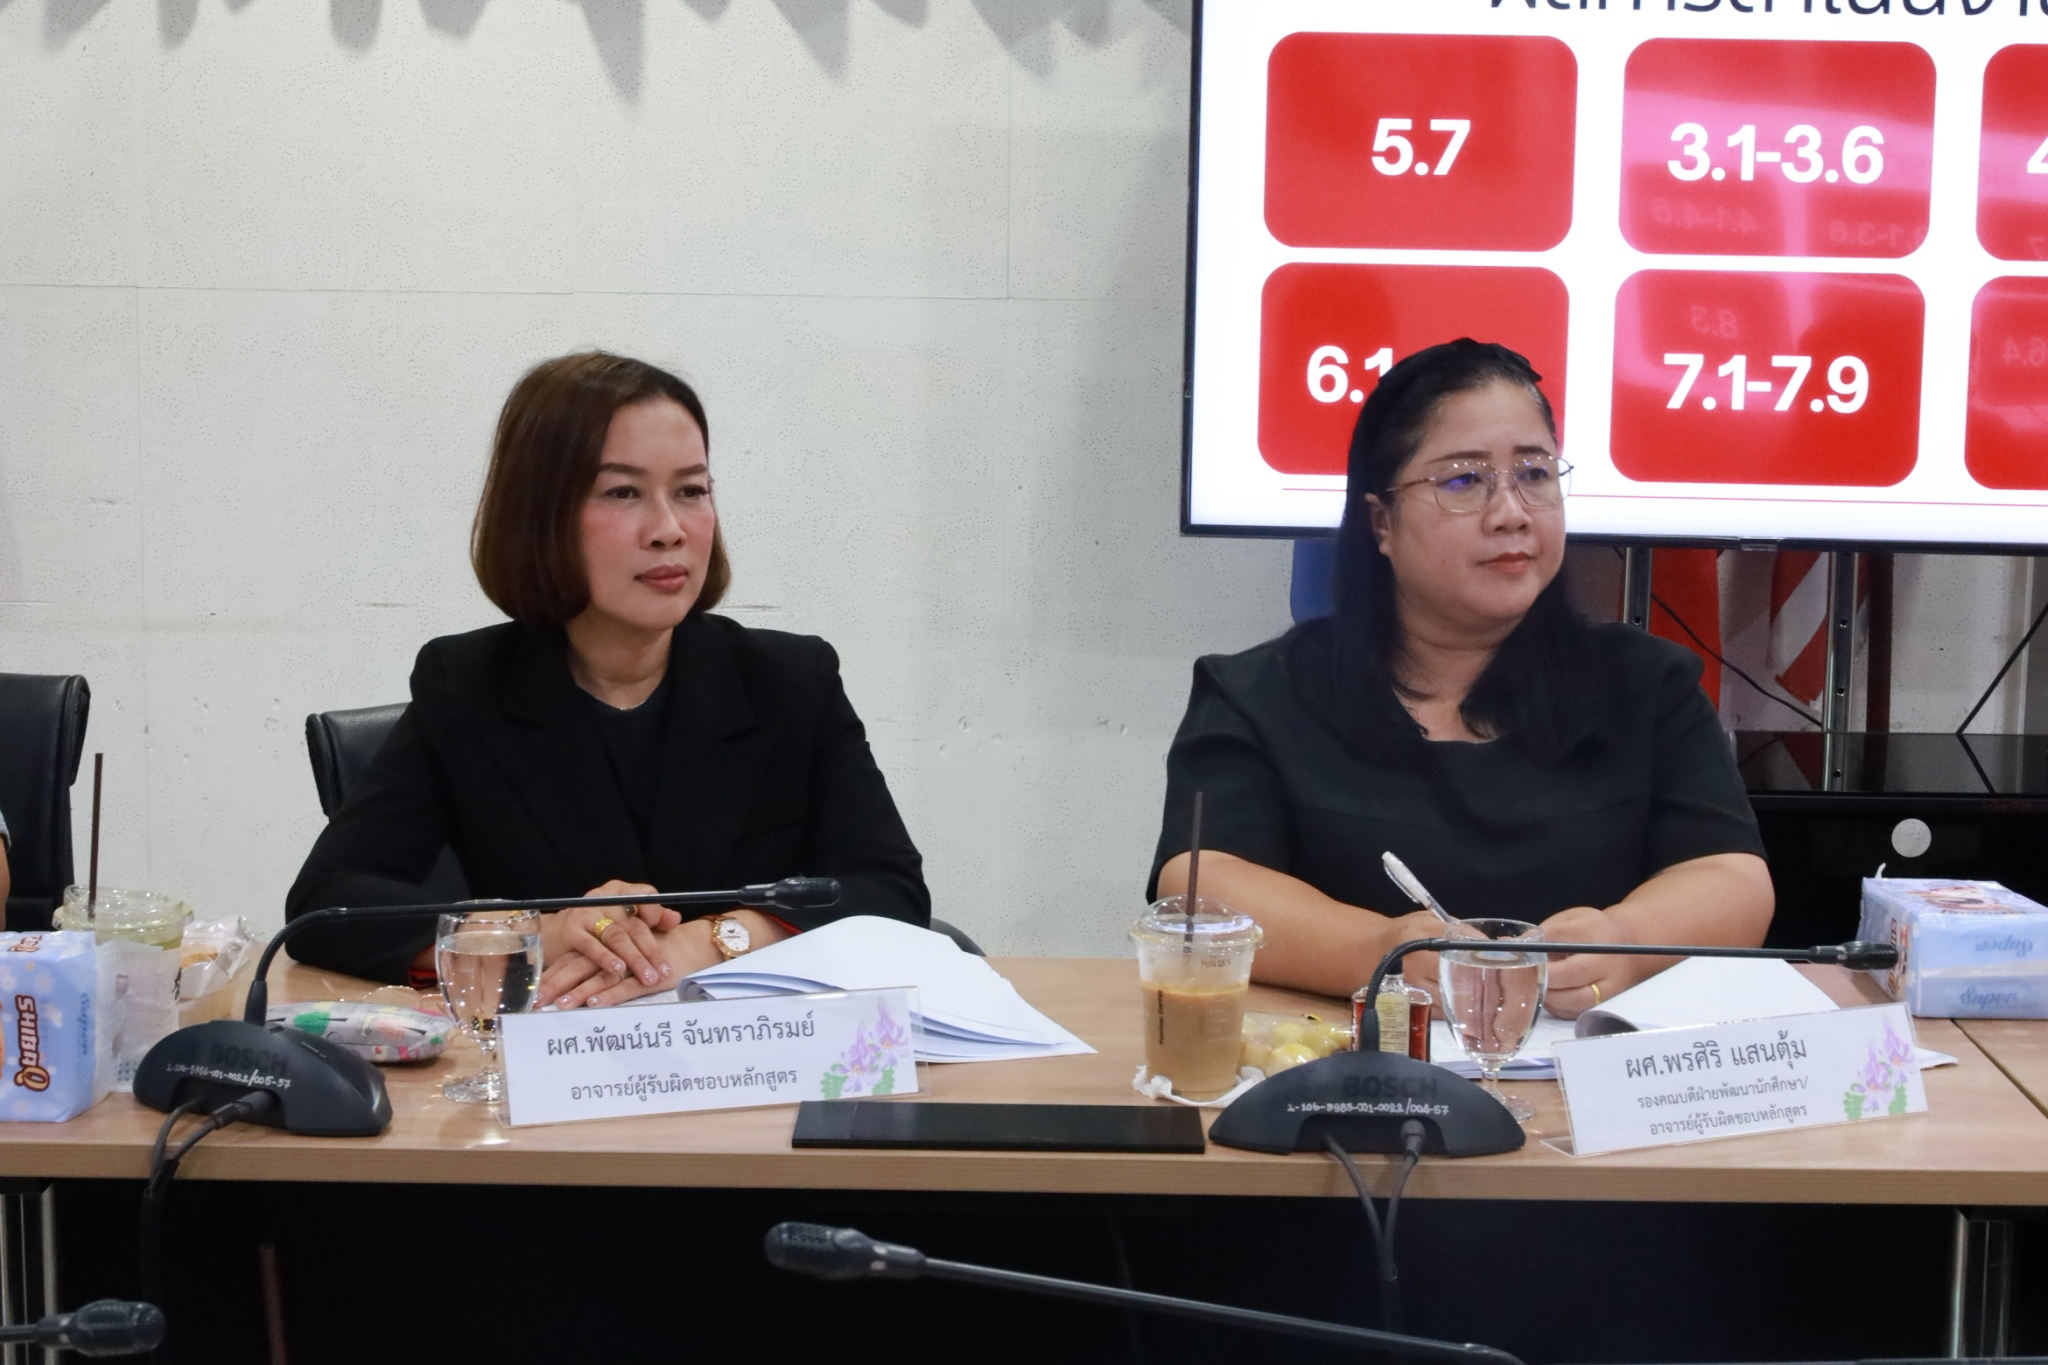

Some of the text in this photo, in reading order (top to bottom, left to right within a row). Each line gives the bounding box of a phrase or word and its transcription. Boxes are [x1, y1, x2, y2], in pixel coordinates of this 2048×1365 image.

[1371, 118, 1471, 176] 5.7
[1667, 122, 1884, 185] 3.1-3.6
[1663, 352, 1869, 414] 7.1-7.9
[547, 1010, 815, 1056] ผศ.พัฒน์นรี จันทราภิรมย์
[1626, 1030, 1807, 1078] ผศ.พรศิริ แสนตุ้ม
[209, 1042, 289, 1075] BOSCH
[570, 1066, 798, 1102] อาจารย์ผู้รับผิดชอบหลักสูตร
[1343, 1075, 1438, 1098] BOSCH
[1650, 1103, 1808, 1135] อาจารย์ผู้รับผิดชอบหลักสูตร
